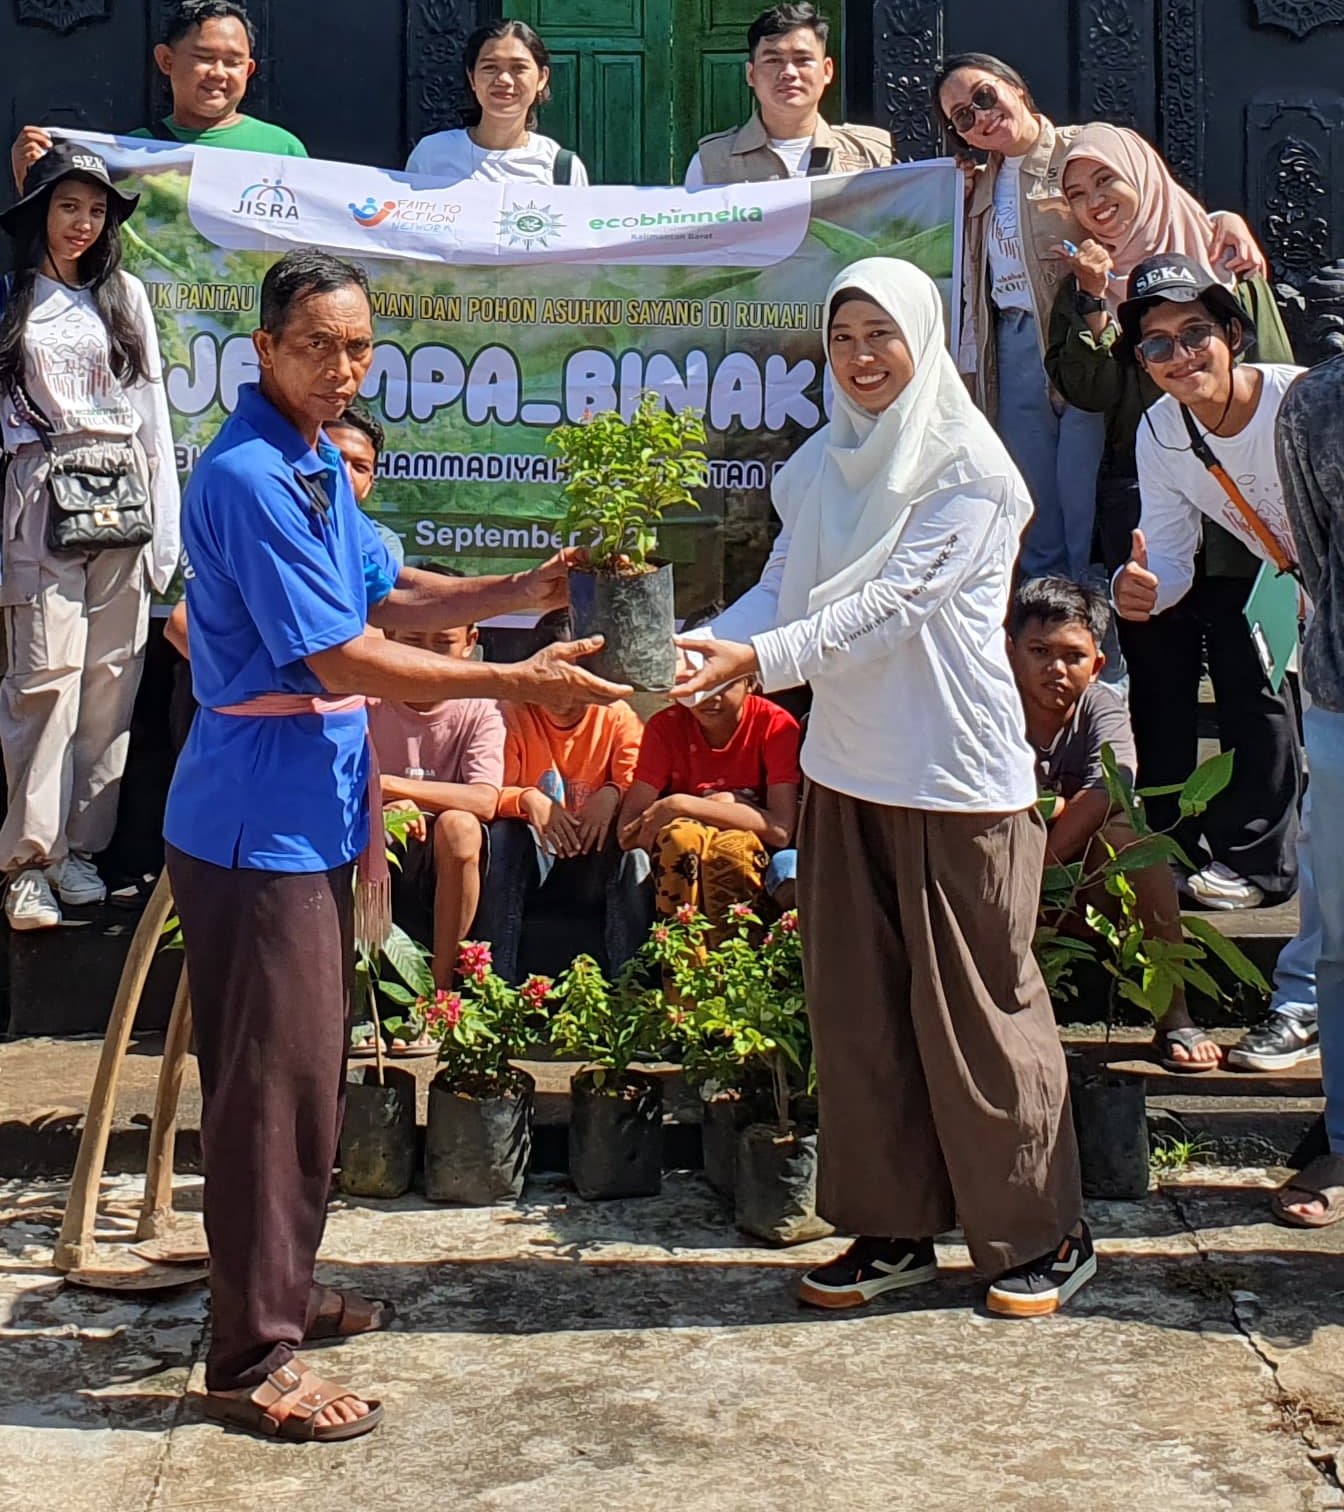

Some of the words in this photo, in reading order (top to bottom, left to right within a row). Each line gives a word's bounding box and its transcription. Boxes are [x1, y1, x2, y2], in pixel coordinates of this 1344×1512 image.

[232, 199, 300, 220] JISRA
[392, 209, 456, 224] ACTION
[397, 199, 436, 211] FAITH
[443, 204, 462, 214] TO
[588, 205, 764, 230] ecobhinneka
[1136, 266, 1196, 293] SEKA
[176, 283, 255, 312] PANTAU
[420, 296, 462, 322] DAN
[468, 297, 537, 324] POHON
[542, 298, 623, 325] ASUHKU
[627, 300, 703, 327] SAYANG
[710, 302, 730, 327] DI
[736, 302, 808, 329] RUMAH
[415, 519, 581, 552] September
